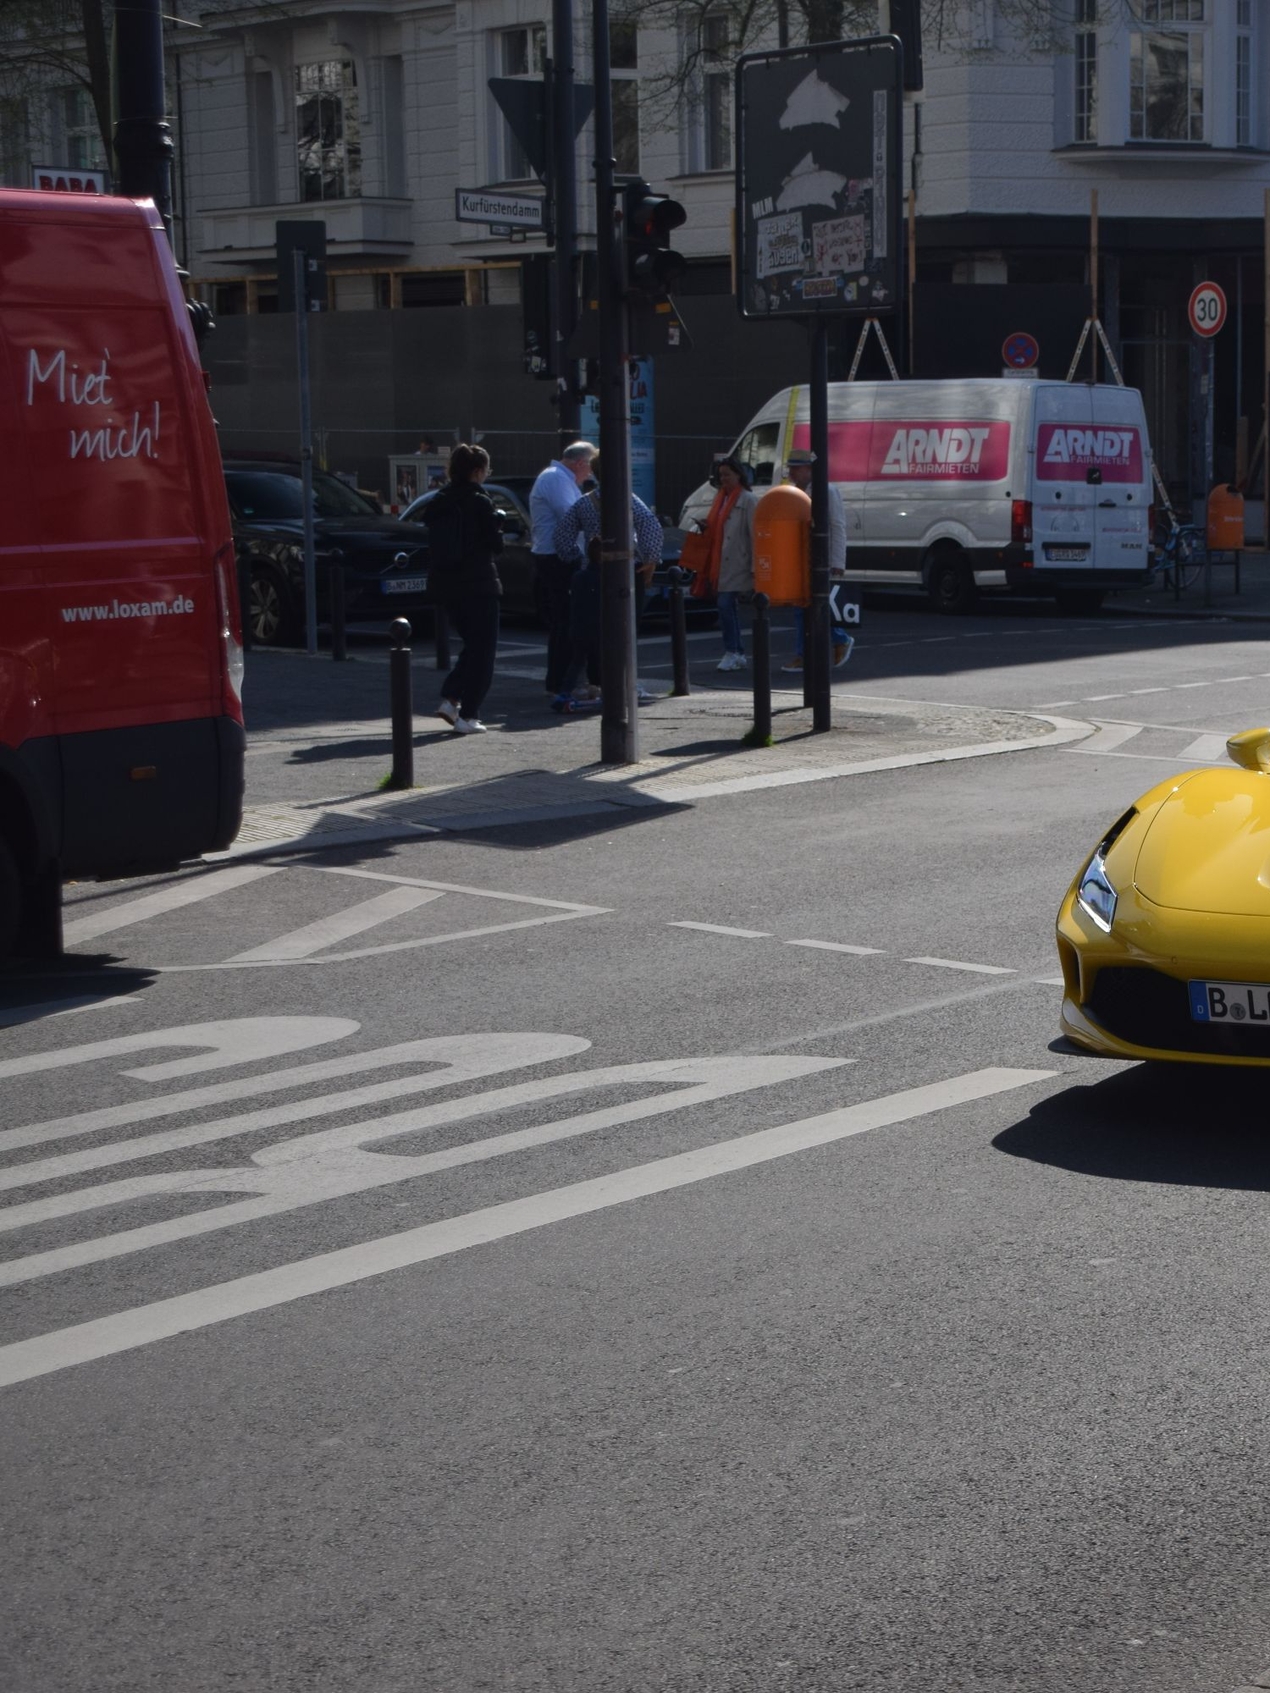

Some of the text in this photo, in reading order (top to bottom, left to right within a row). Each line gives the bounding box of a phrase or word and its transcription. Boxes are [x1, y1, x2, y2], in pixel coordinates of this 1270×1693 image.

[39, 175, 98, 193] BABA
[462, 196, 540, 218] Kurfürstendamm
[1196, 297, 1218, 321] 30
[69, 400, 160, 462] mich!
[881, 428, 990, 474] ARNDT
[1043, 430, 1134, 463] ARNDT
[908, 463, 980, 474] FAIRMIETEN
[1071, 455, 1130, 466] FAIRMIETEN
[62, 594, 195, 622] www.loxam.de
[1208, 987, 1228, 1018] B
